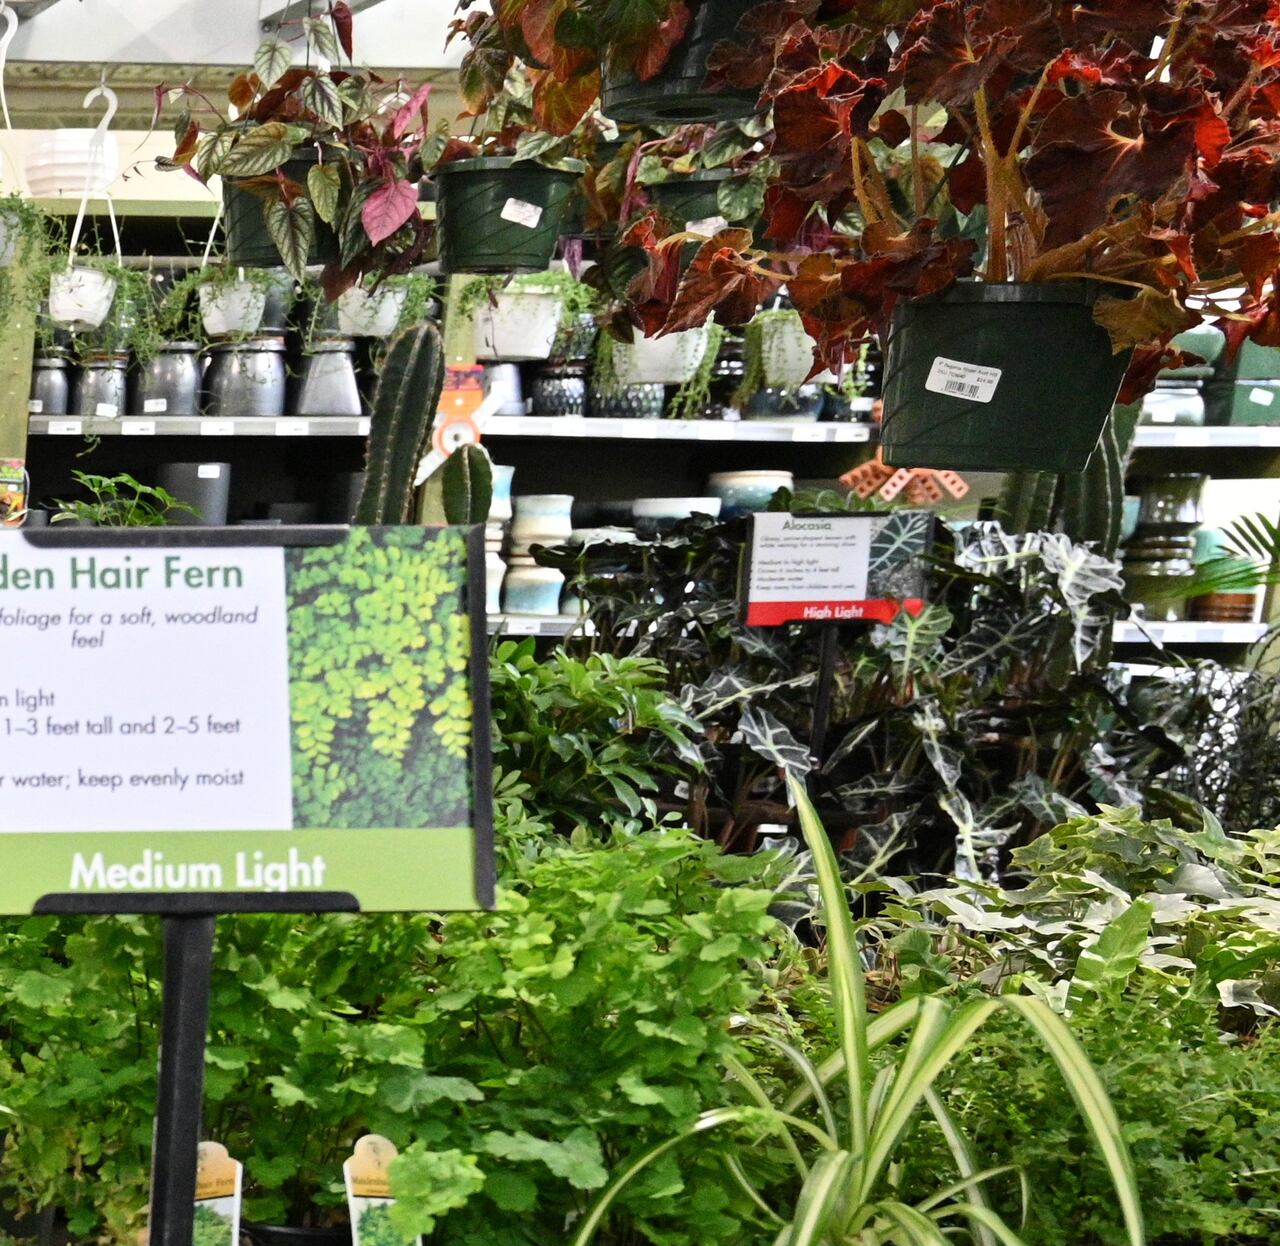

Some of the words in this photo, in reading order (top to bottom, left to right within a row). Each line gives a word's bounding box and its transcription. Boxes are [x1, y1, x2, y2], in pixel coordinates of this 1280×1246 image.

[782, 520, 832, 531] Alocasia
[71, 556, 150, 589] Hair
[164, 556, 242, 588] Fern
[68, 606, 93, 626] for
[100, 613, 112, 626] a
[120, 606, 156, 628] soft,
[165, 605, 259, 625] woodland
[803, 607, 832, 618] High
[834, 606, 864, 618] Light
[71, 629, 105, 648] feel
[16, 688, 55, 713] light
[46, 716, 79, 736] feet
[86, 716, 112, 735] tall
[120, 714, 156, 735] and
[207, 714, 240, 734] feet
[12, 773, 71, 790] water;
[78, 768, 123, 792] keep
[130, 767, 190, 792] evenly
[196, 769, 244, 786] moist
[69, 848, 223, 889] Medium
[236, 847, 326, 893] Light
